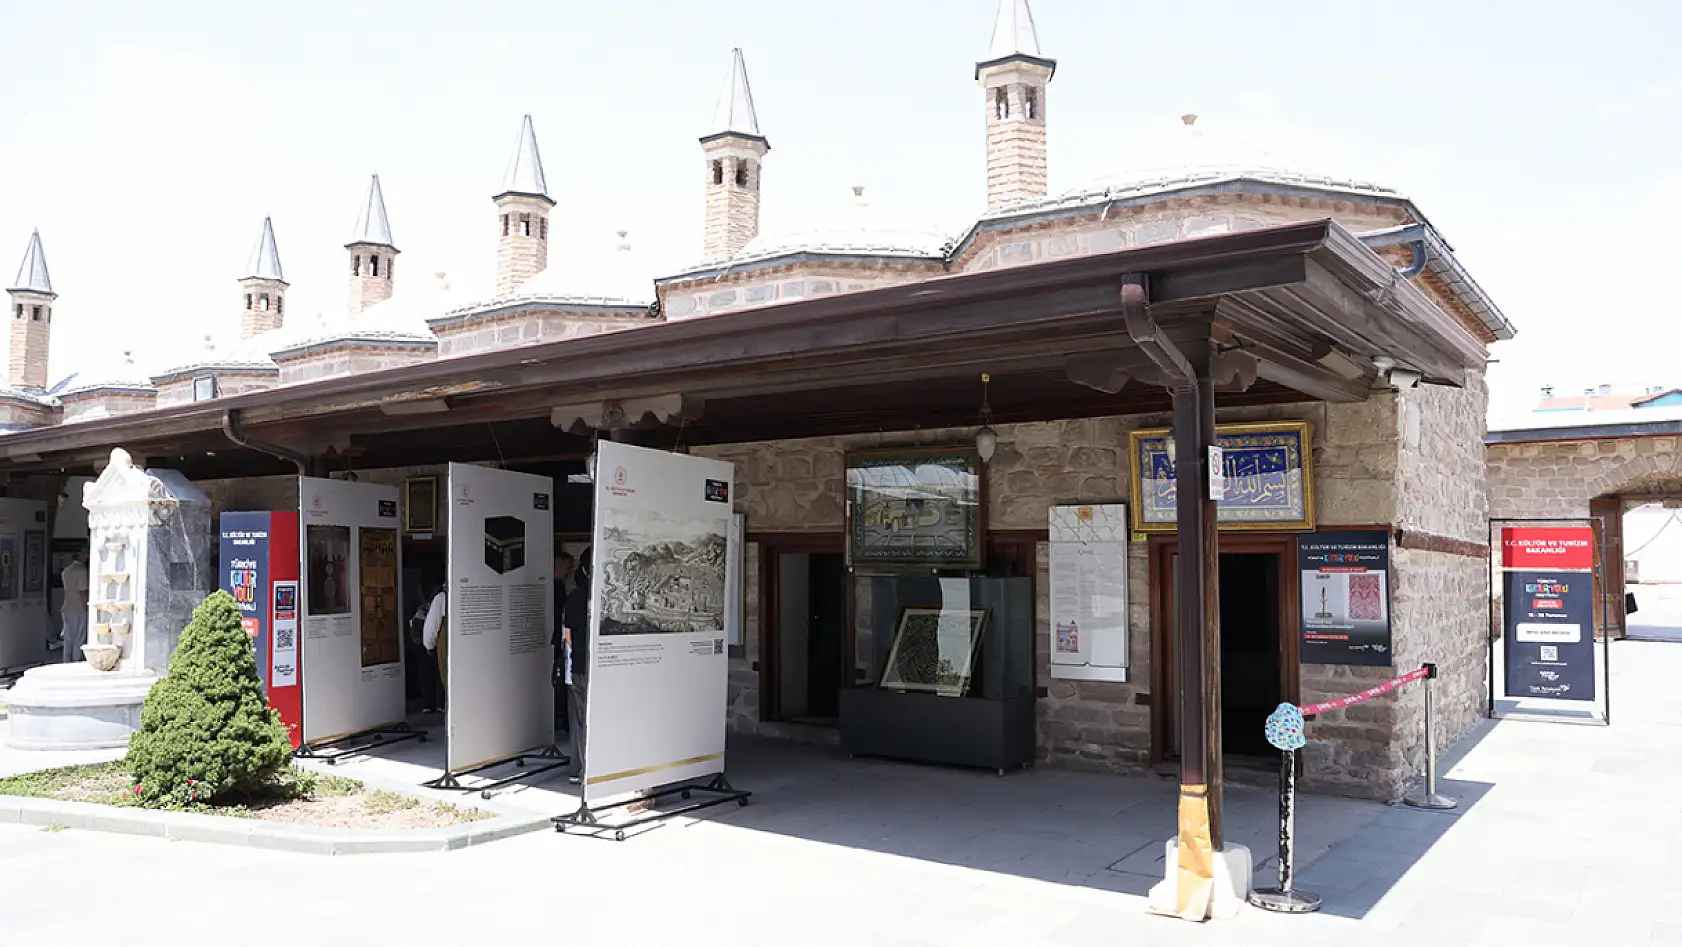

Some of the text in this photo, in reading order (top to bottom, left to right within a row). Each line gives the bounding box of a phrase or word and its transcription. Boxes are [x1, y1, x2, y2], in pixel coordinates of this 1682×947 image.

[1518, 539, 1546, 547] KÜLTÜR
[1559, 539, 1588, 547] TURİZM
[1525, 546, 1567, 554] BAKANLIĞI
